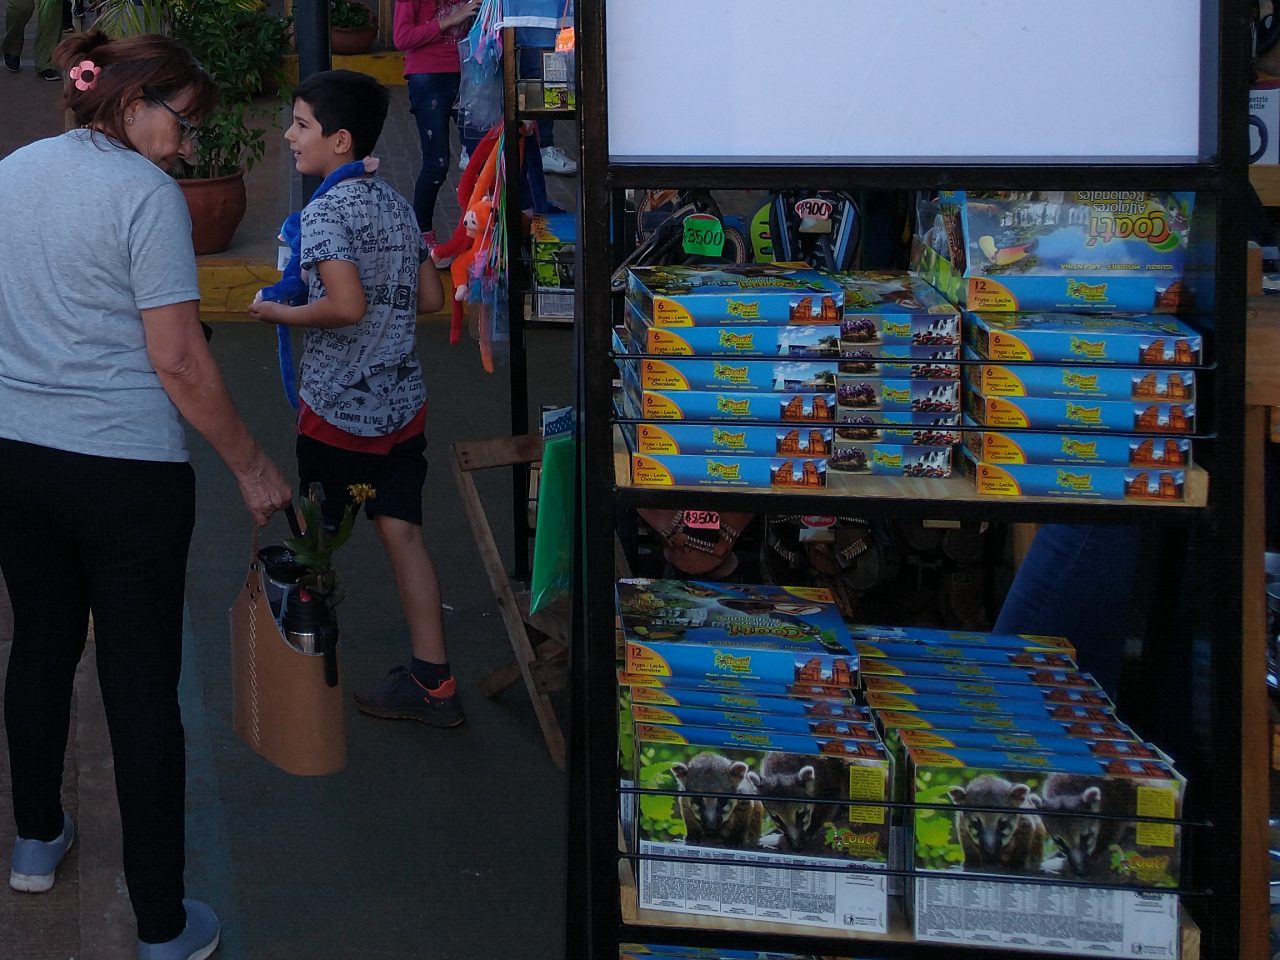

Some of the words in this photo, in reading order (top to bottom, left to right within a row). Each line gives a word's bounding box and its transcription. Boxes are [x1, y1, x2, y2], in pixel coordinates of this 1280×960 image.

[1092, 201, 1146, 214] Alfajores
[688, 228, 722, 246] 3500
[976, 281, 986, 290] 12
[658, 302, 664, 310] 6
[654, 332, 660, 340] 6
[647, 396, 653, 404] 6
[991, 402, 997, 410] 6
[364, 416, 382, 425] LIVE
[643, 428, 648, 436] 6
[637, 459, 643, 467] 6
[632, 648, 641, 656] 12
